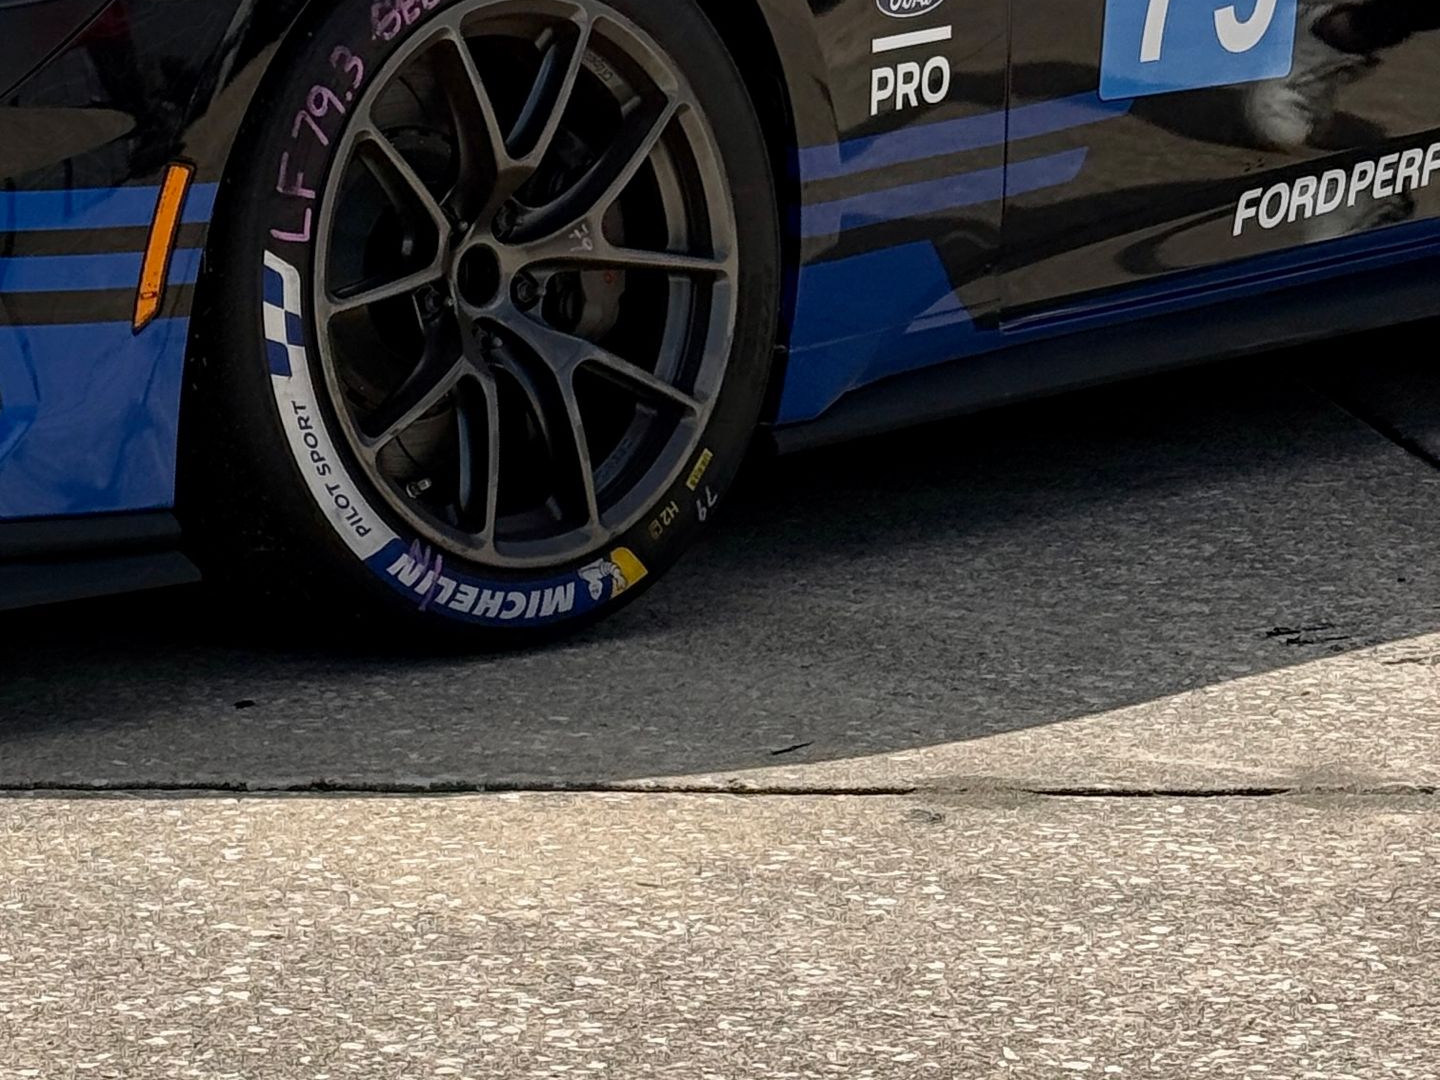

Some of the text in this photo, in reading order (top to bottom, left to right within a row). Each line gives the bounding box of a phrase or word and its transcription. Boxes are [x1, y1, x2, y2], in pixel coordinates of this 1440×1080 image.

[870, 55, 951, 116] PRO
[270, 151, 316, 242] LF
[291, 400, 372, 538] PILOT SPORT
[386, 553, 575, 620] MICHELIN
